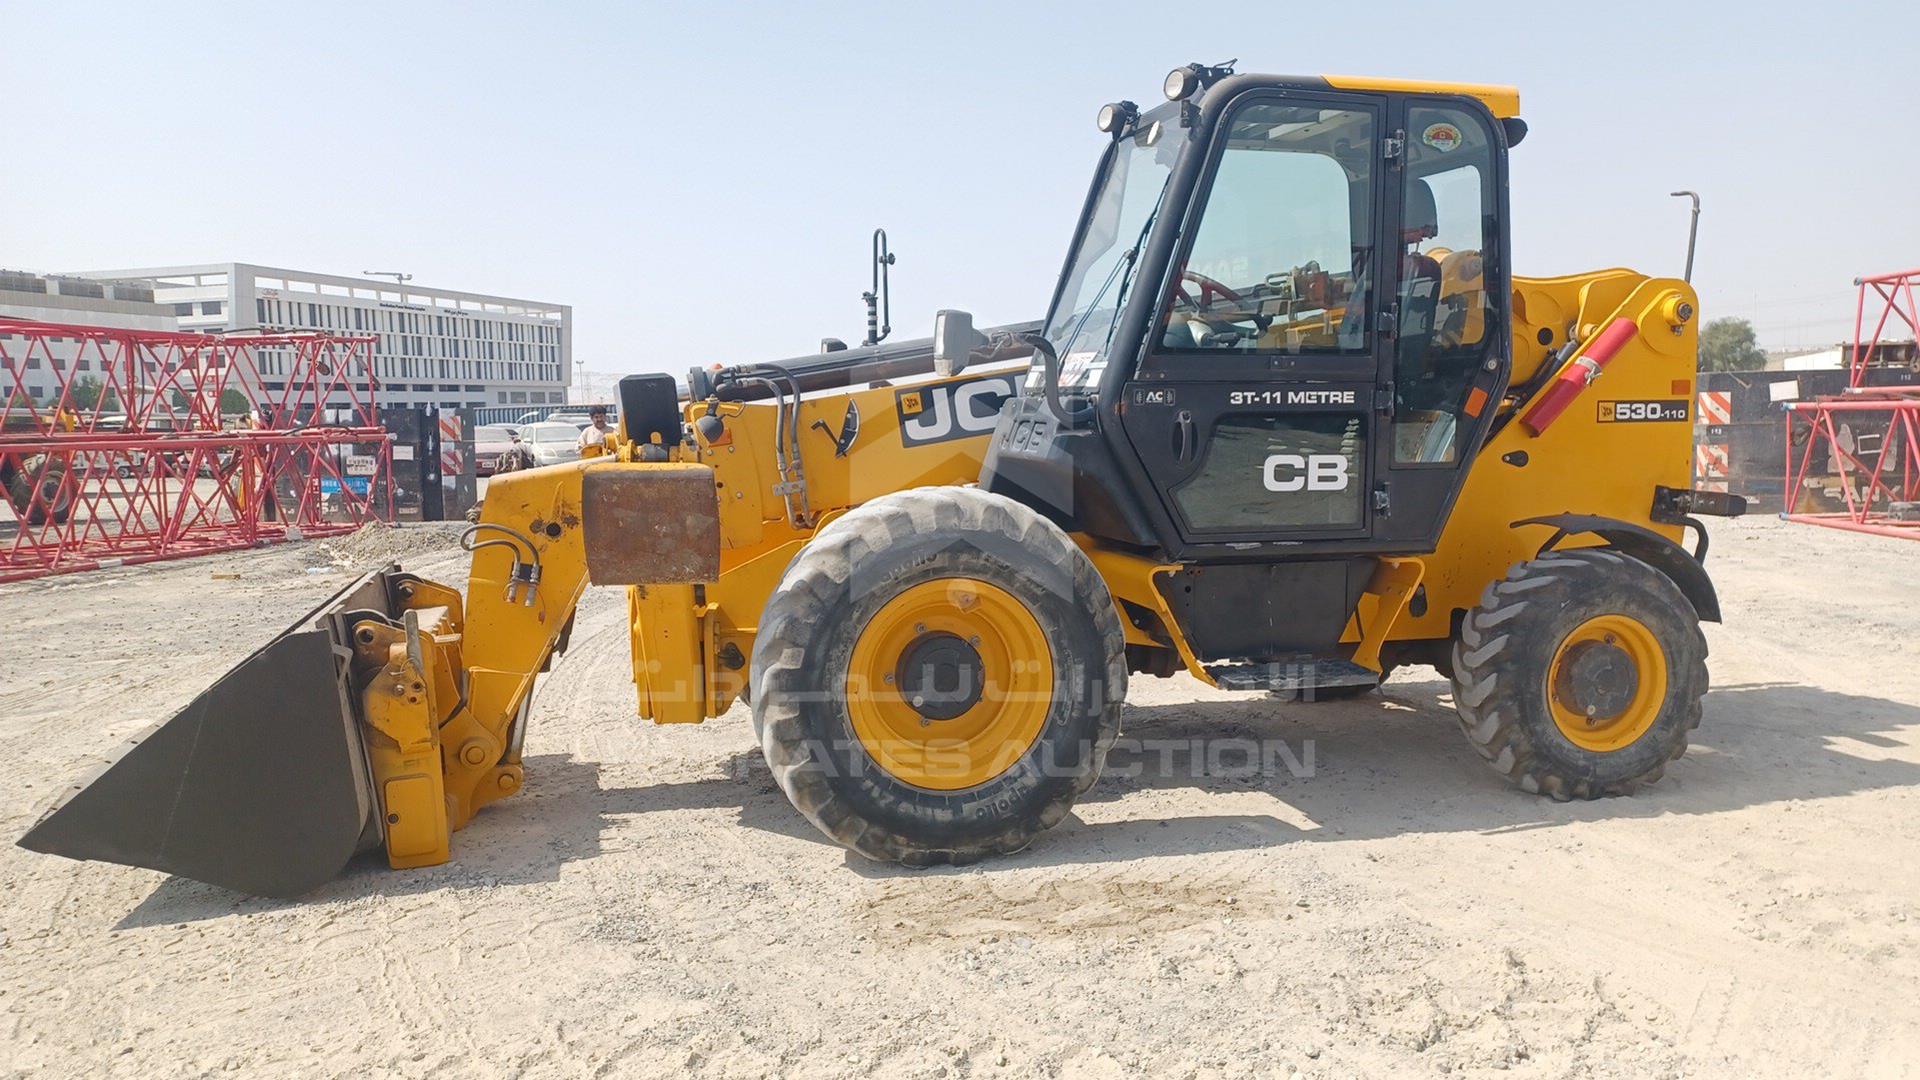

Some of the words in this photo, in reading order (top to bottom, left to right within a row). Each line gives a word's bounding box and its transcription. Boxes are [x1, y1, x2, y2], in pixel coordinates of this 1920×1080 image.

[1146, 391, 1163, 401] AC
[1230, 391, 1281, 404] 3T-11
[1288, 391, 1355, 404] METRE
[905, 378, 1028, 440] JC
[1263, 454, 1349, 492] CB
